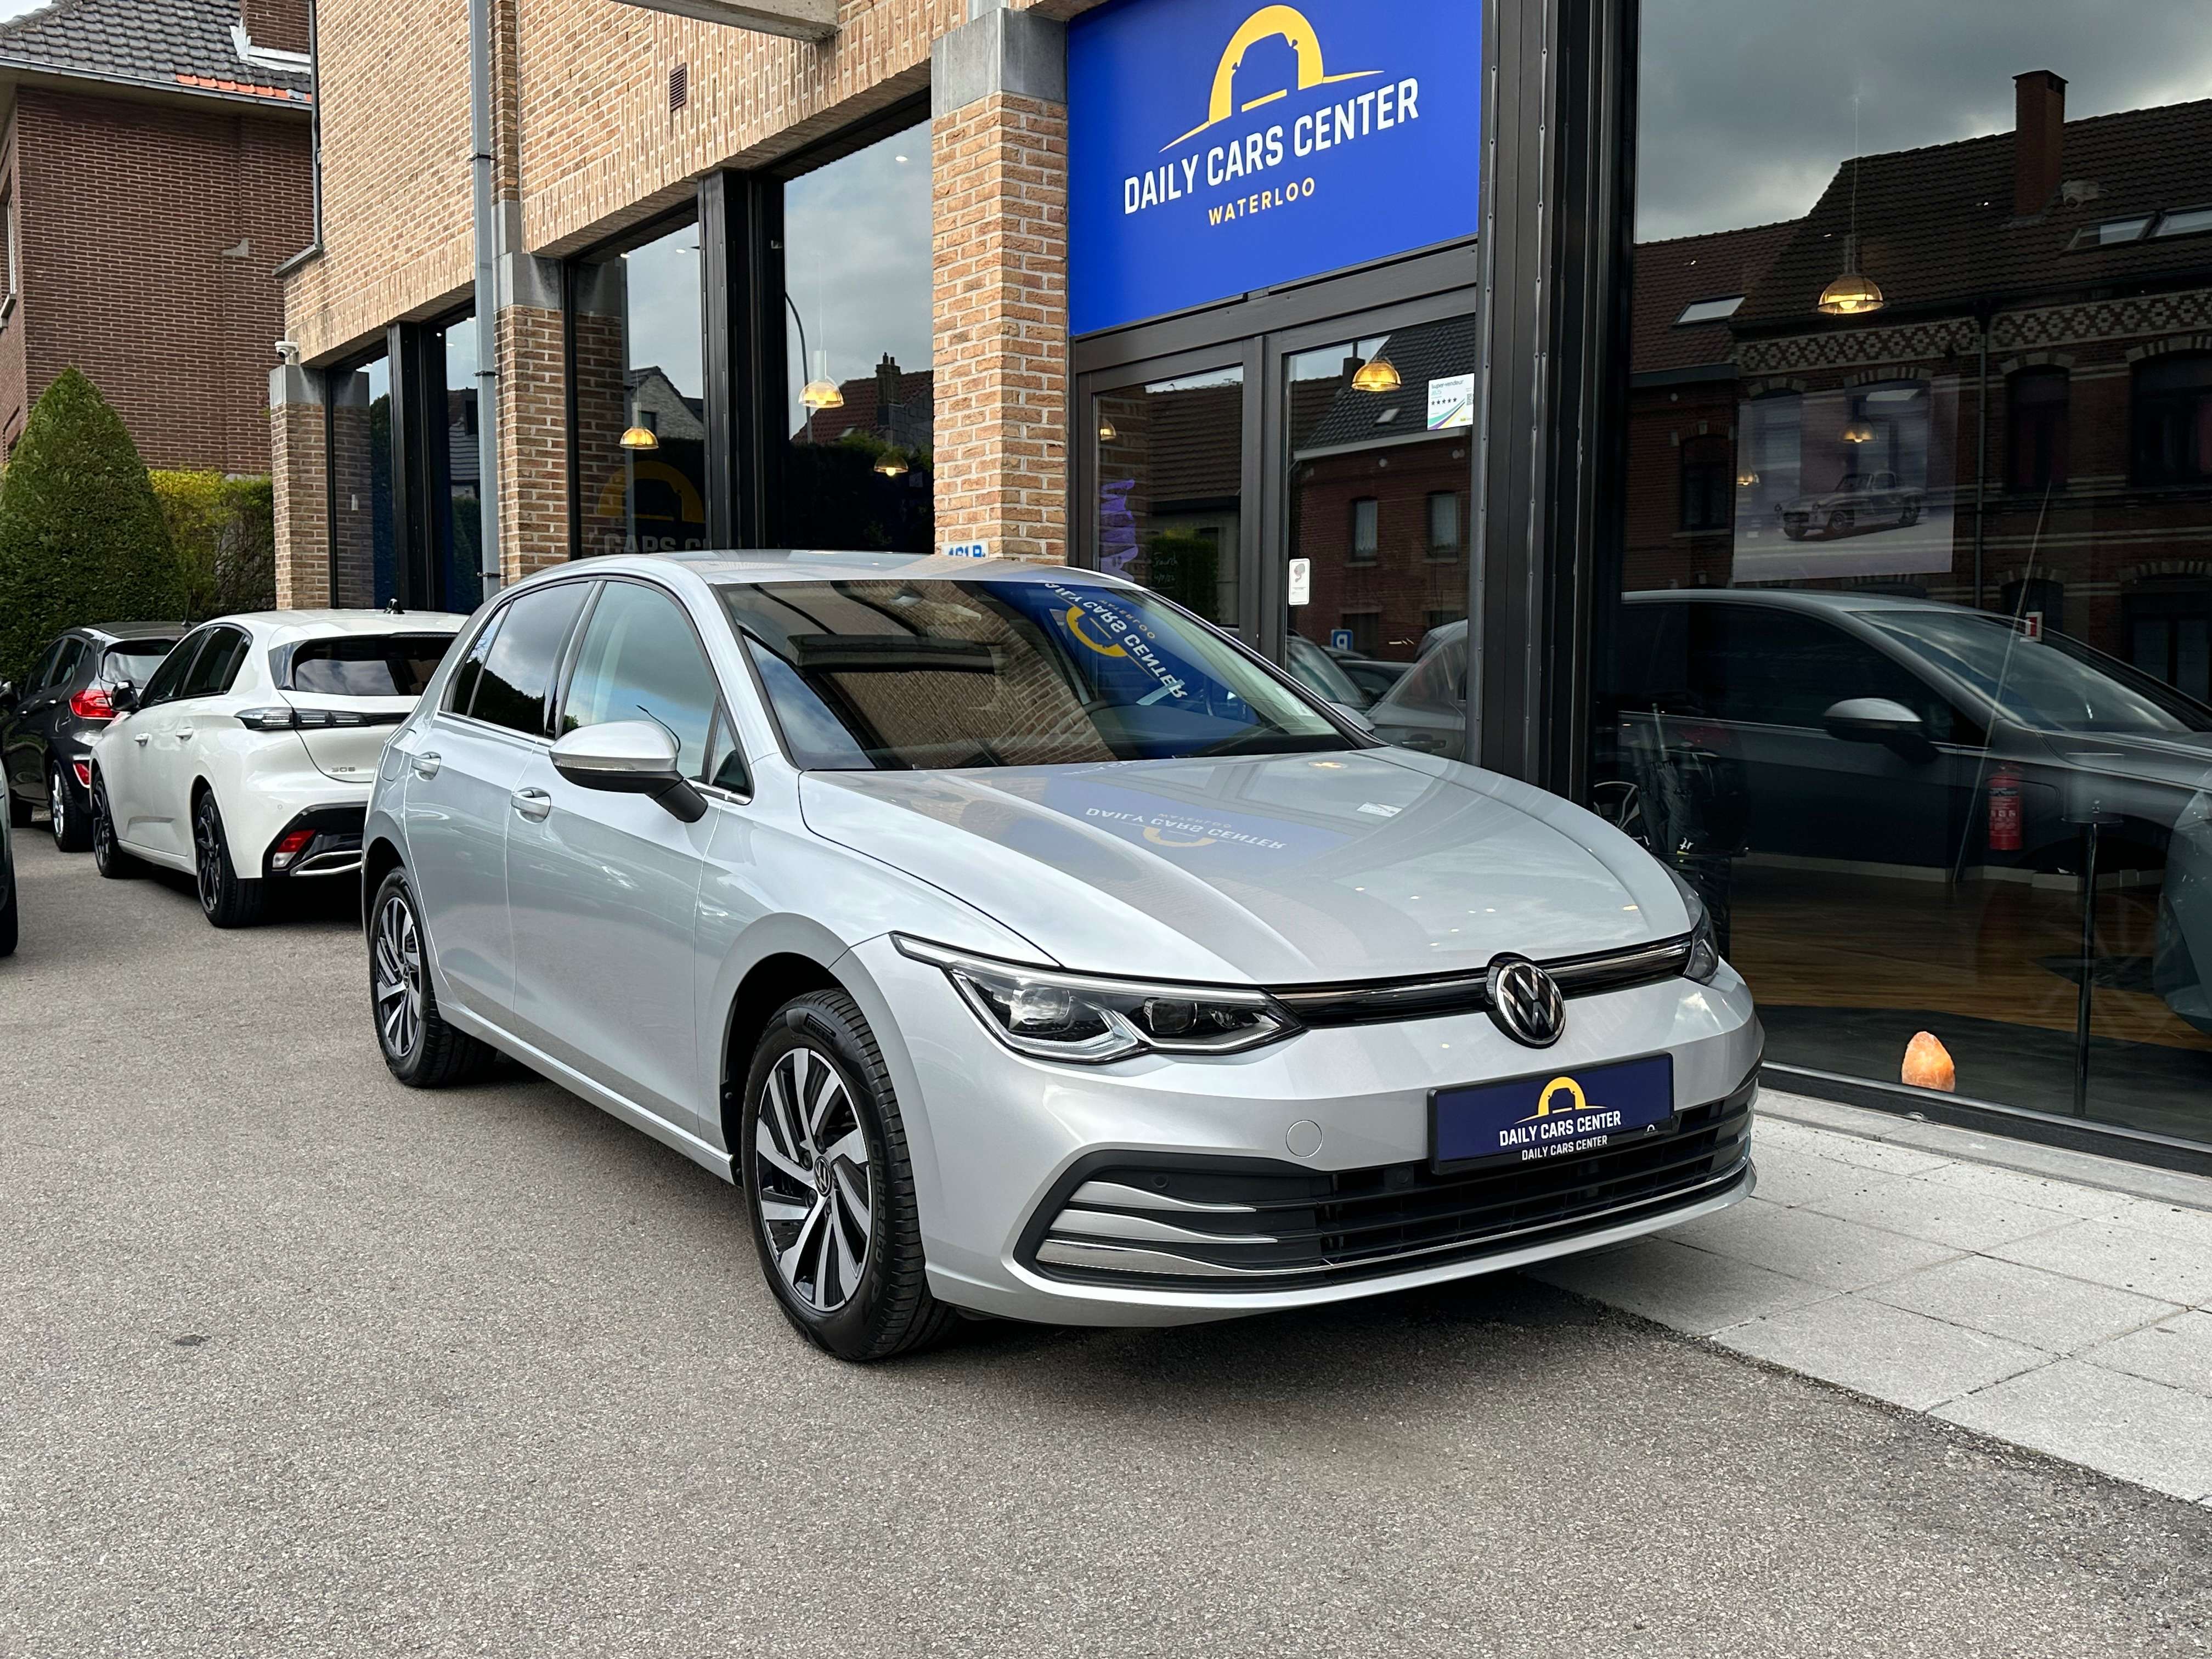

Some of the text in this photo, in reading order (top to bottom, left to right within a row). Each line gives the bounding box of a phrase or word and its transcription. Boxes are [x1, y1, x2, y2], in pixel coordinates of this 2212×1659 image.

[1125, 77, 1419, 215] DAILY CARS CENTER
[1209, 177, 1316, 226] WATERLOO
[1499, 1110, 1621, 1147] DAILY CARS CENTER
[1522, 1135, 1607, 1161] DAILY CARS CENTER
